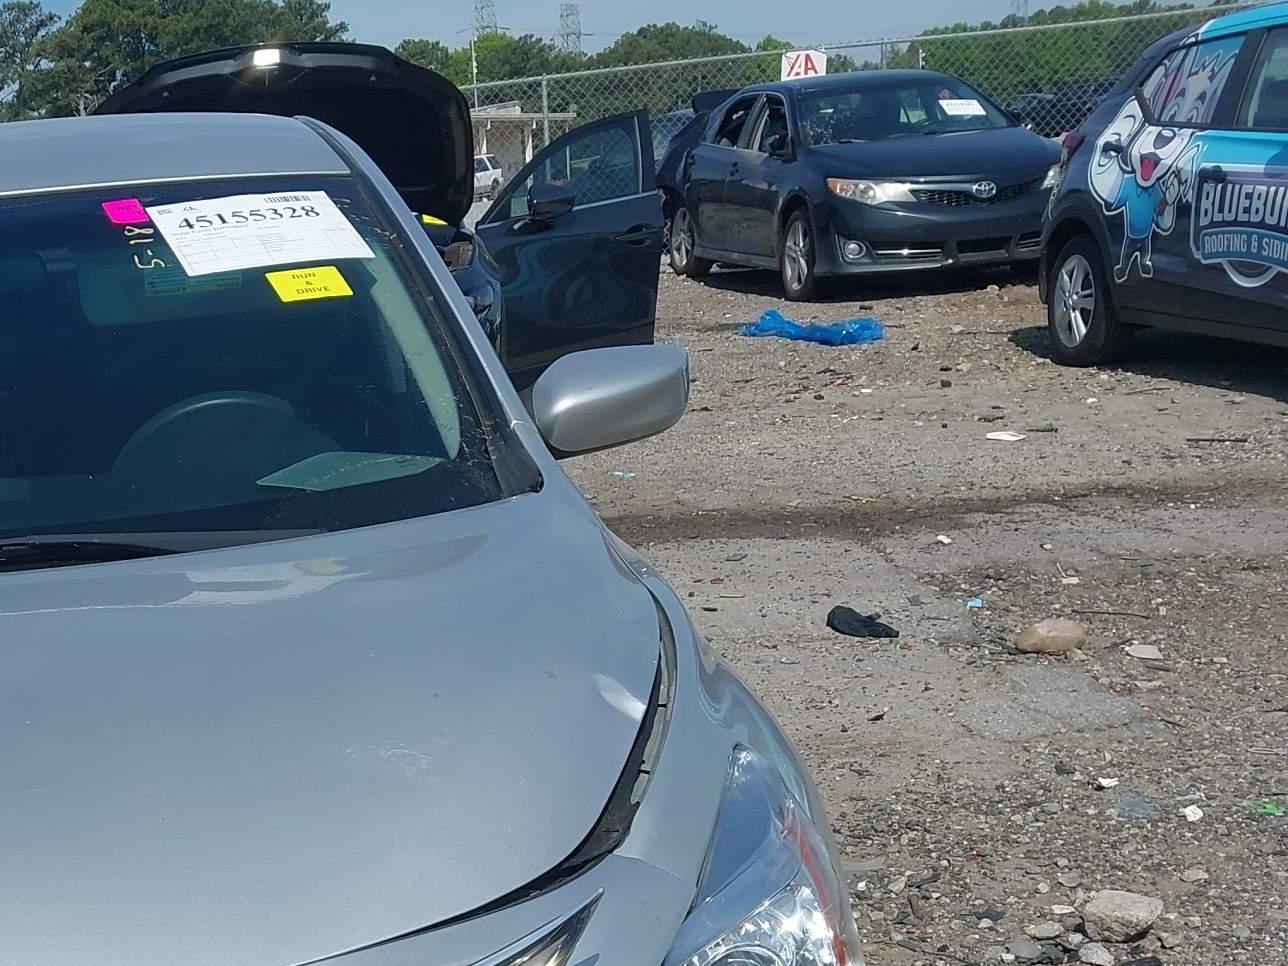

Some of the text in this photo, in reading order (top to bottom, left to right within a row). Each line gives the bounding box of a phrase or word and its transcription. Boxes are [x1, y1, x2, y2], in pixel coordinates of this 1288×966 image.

[178, 205, 321, 230] 45155328
[1204, 233, 1247, 253] ROOFING
[1261, 237, 1288, 261] SIDI
[291, 271, 317, 280] RUN
[295, 285, 332, 295] DRIVE
